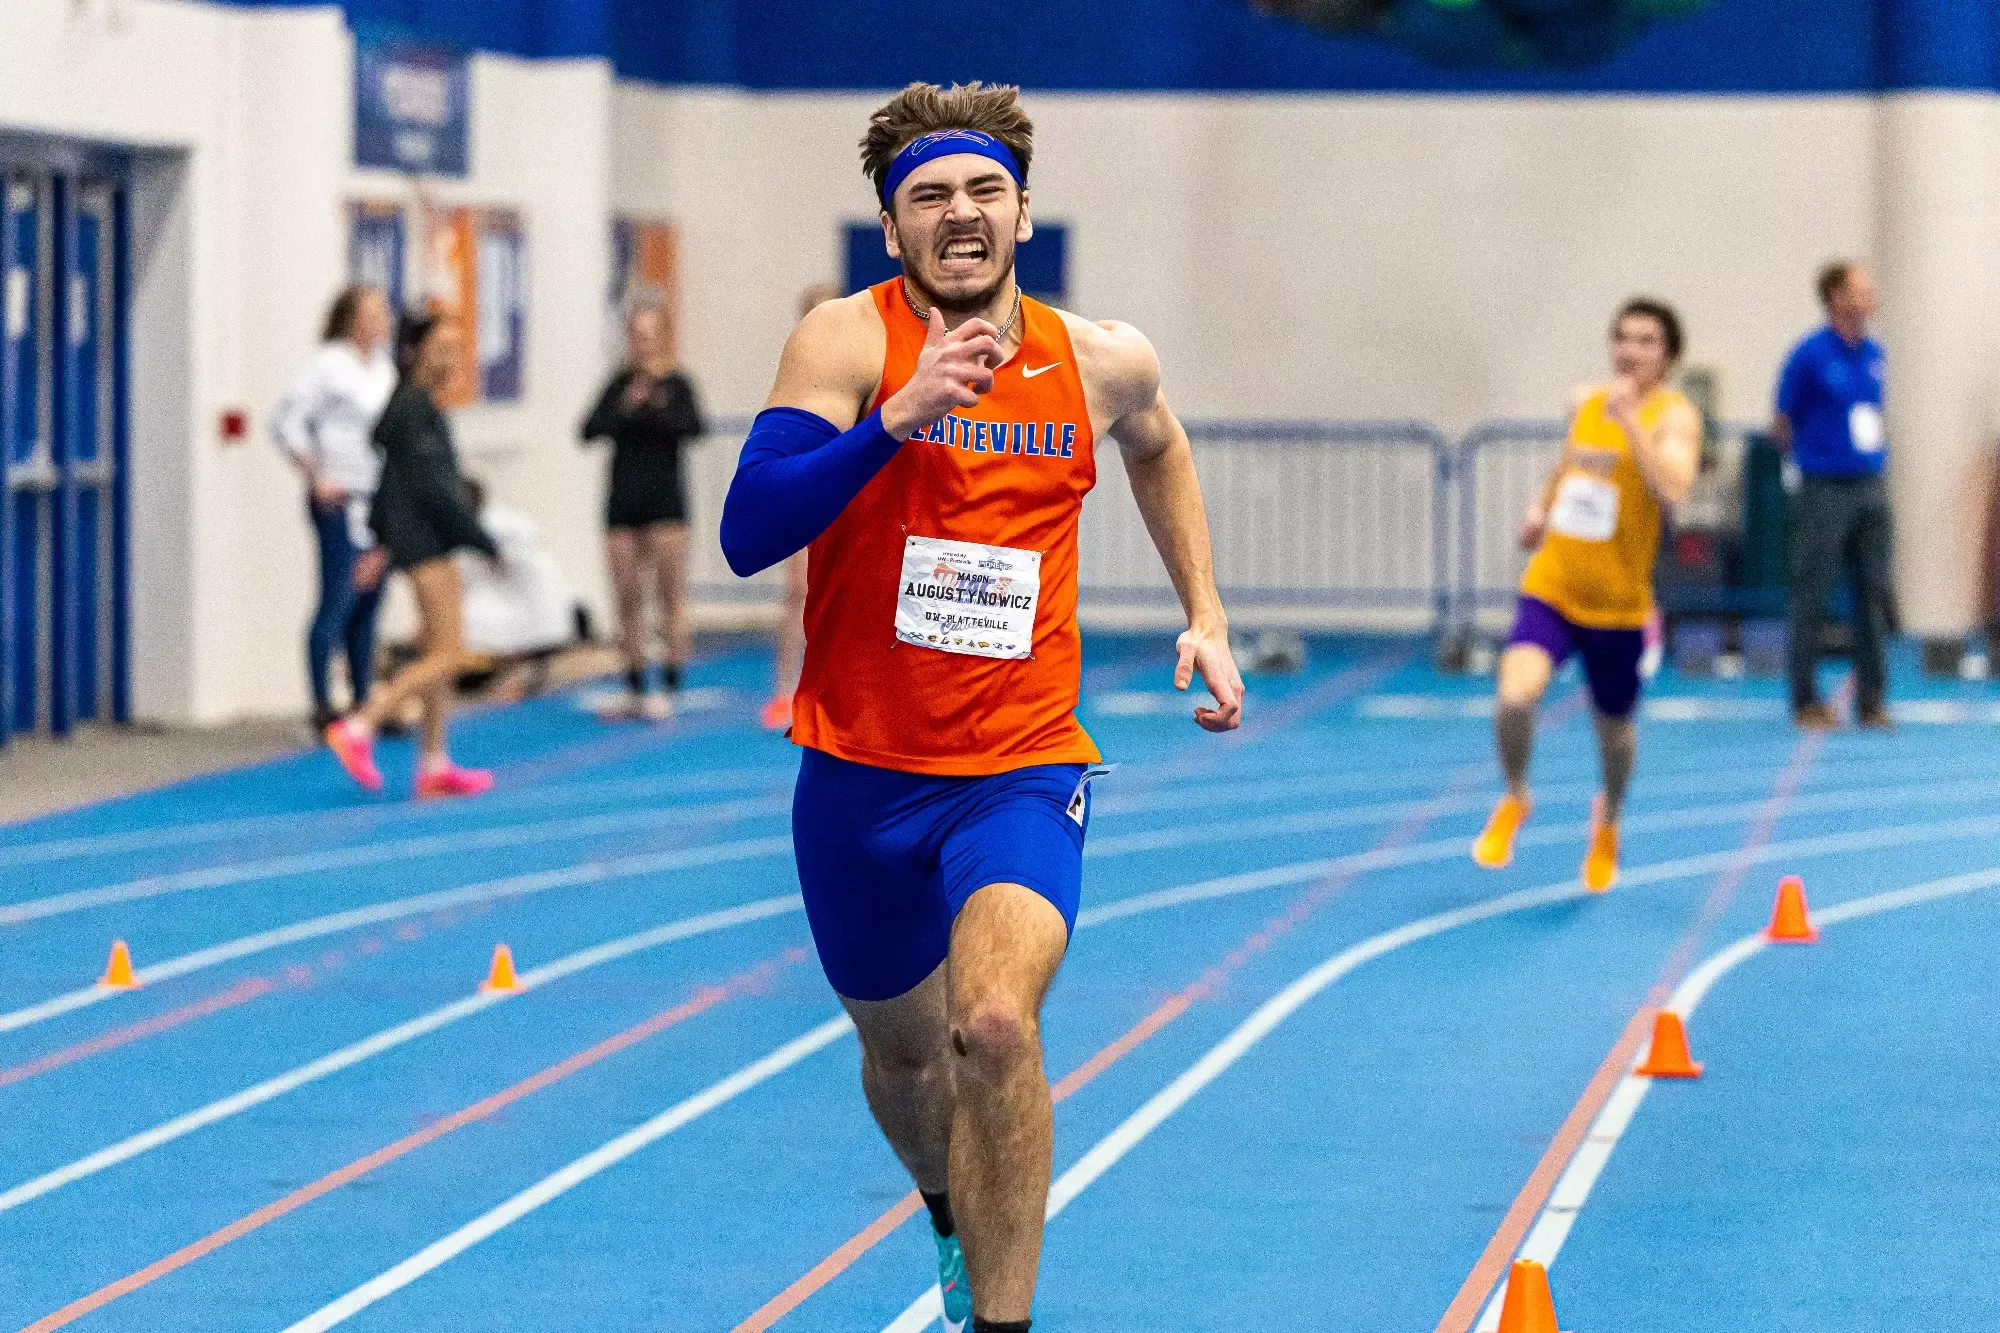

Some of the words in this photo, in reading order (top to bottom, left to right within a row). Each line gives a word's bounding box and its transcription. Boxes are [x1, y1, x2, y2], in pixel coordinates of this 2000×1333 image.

[909, 413, 1076, 459] LATTEVILLE
[957, 572, 990, 584] MASON
[904, 582, 1032, 610] AUGUSTYNOWICZ
[925, 611, 1009, 630] UW-PLATTEVILLE
